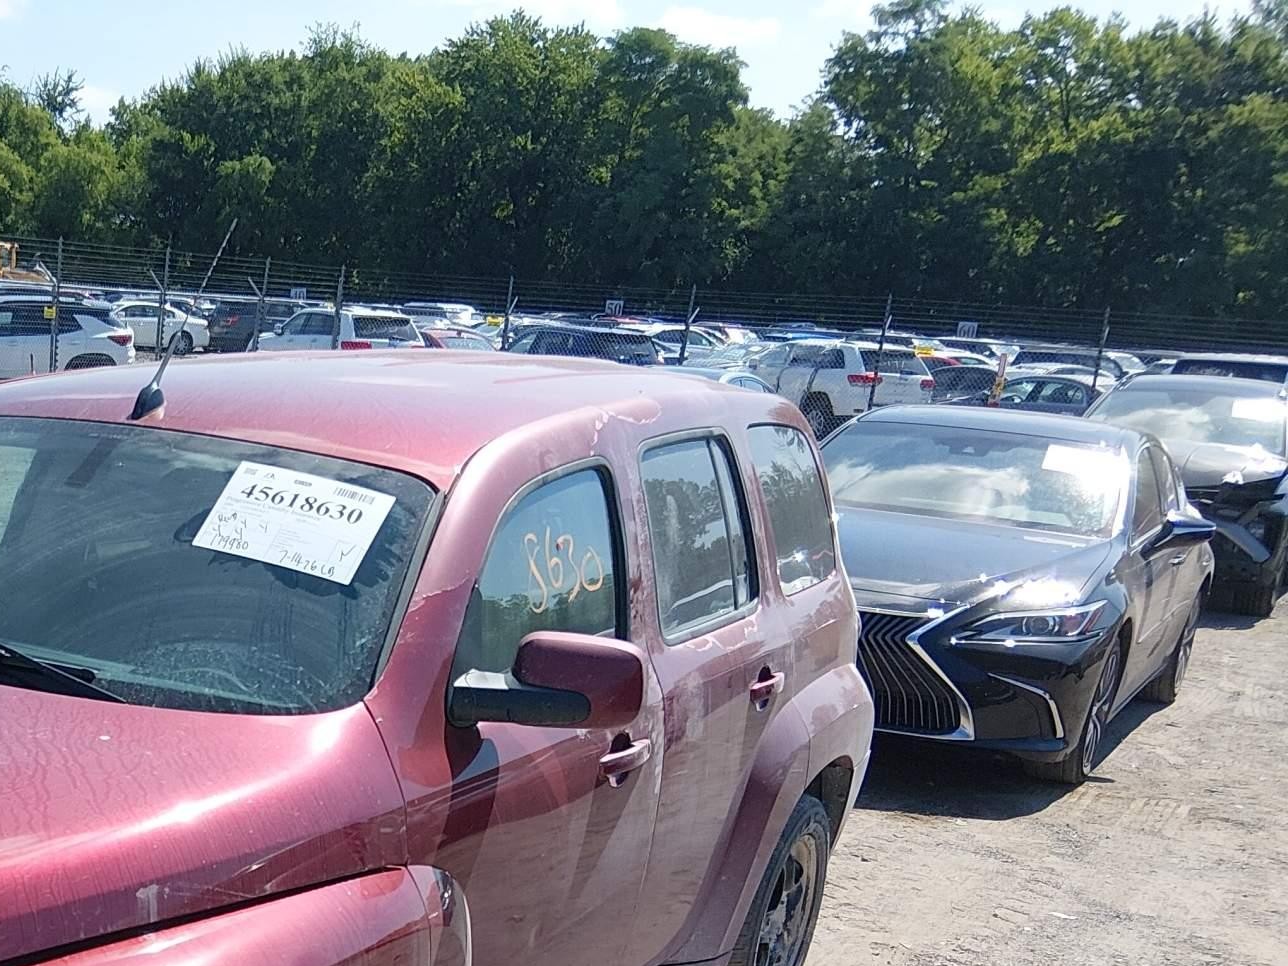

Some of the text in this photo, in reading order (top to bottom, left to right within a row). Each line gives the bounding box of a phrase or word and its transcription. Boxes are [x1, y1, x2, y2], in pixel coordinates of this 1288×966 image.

[608, 302, 622, 315] 50
[240, 483, 363, 525] 45618630
[523, 526, 604, 614] 8630
